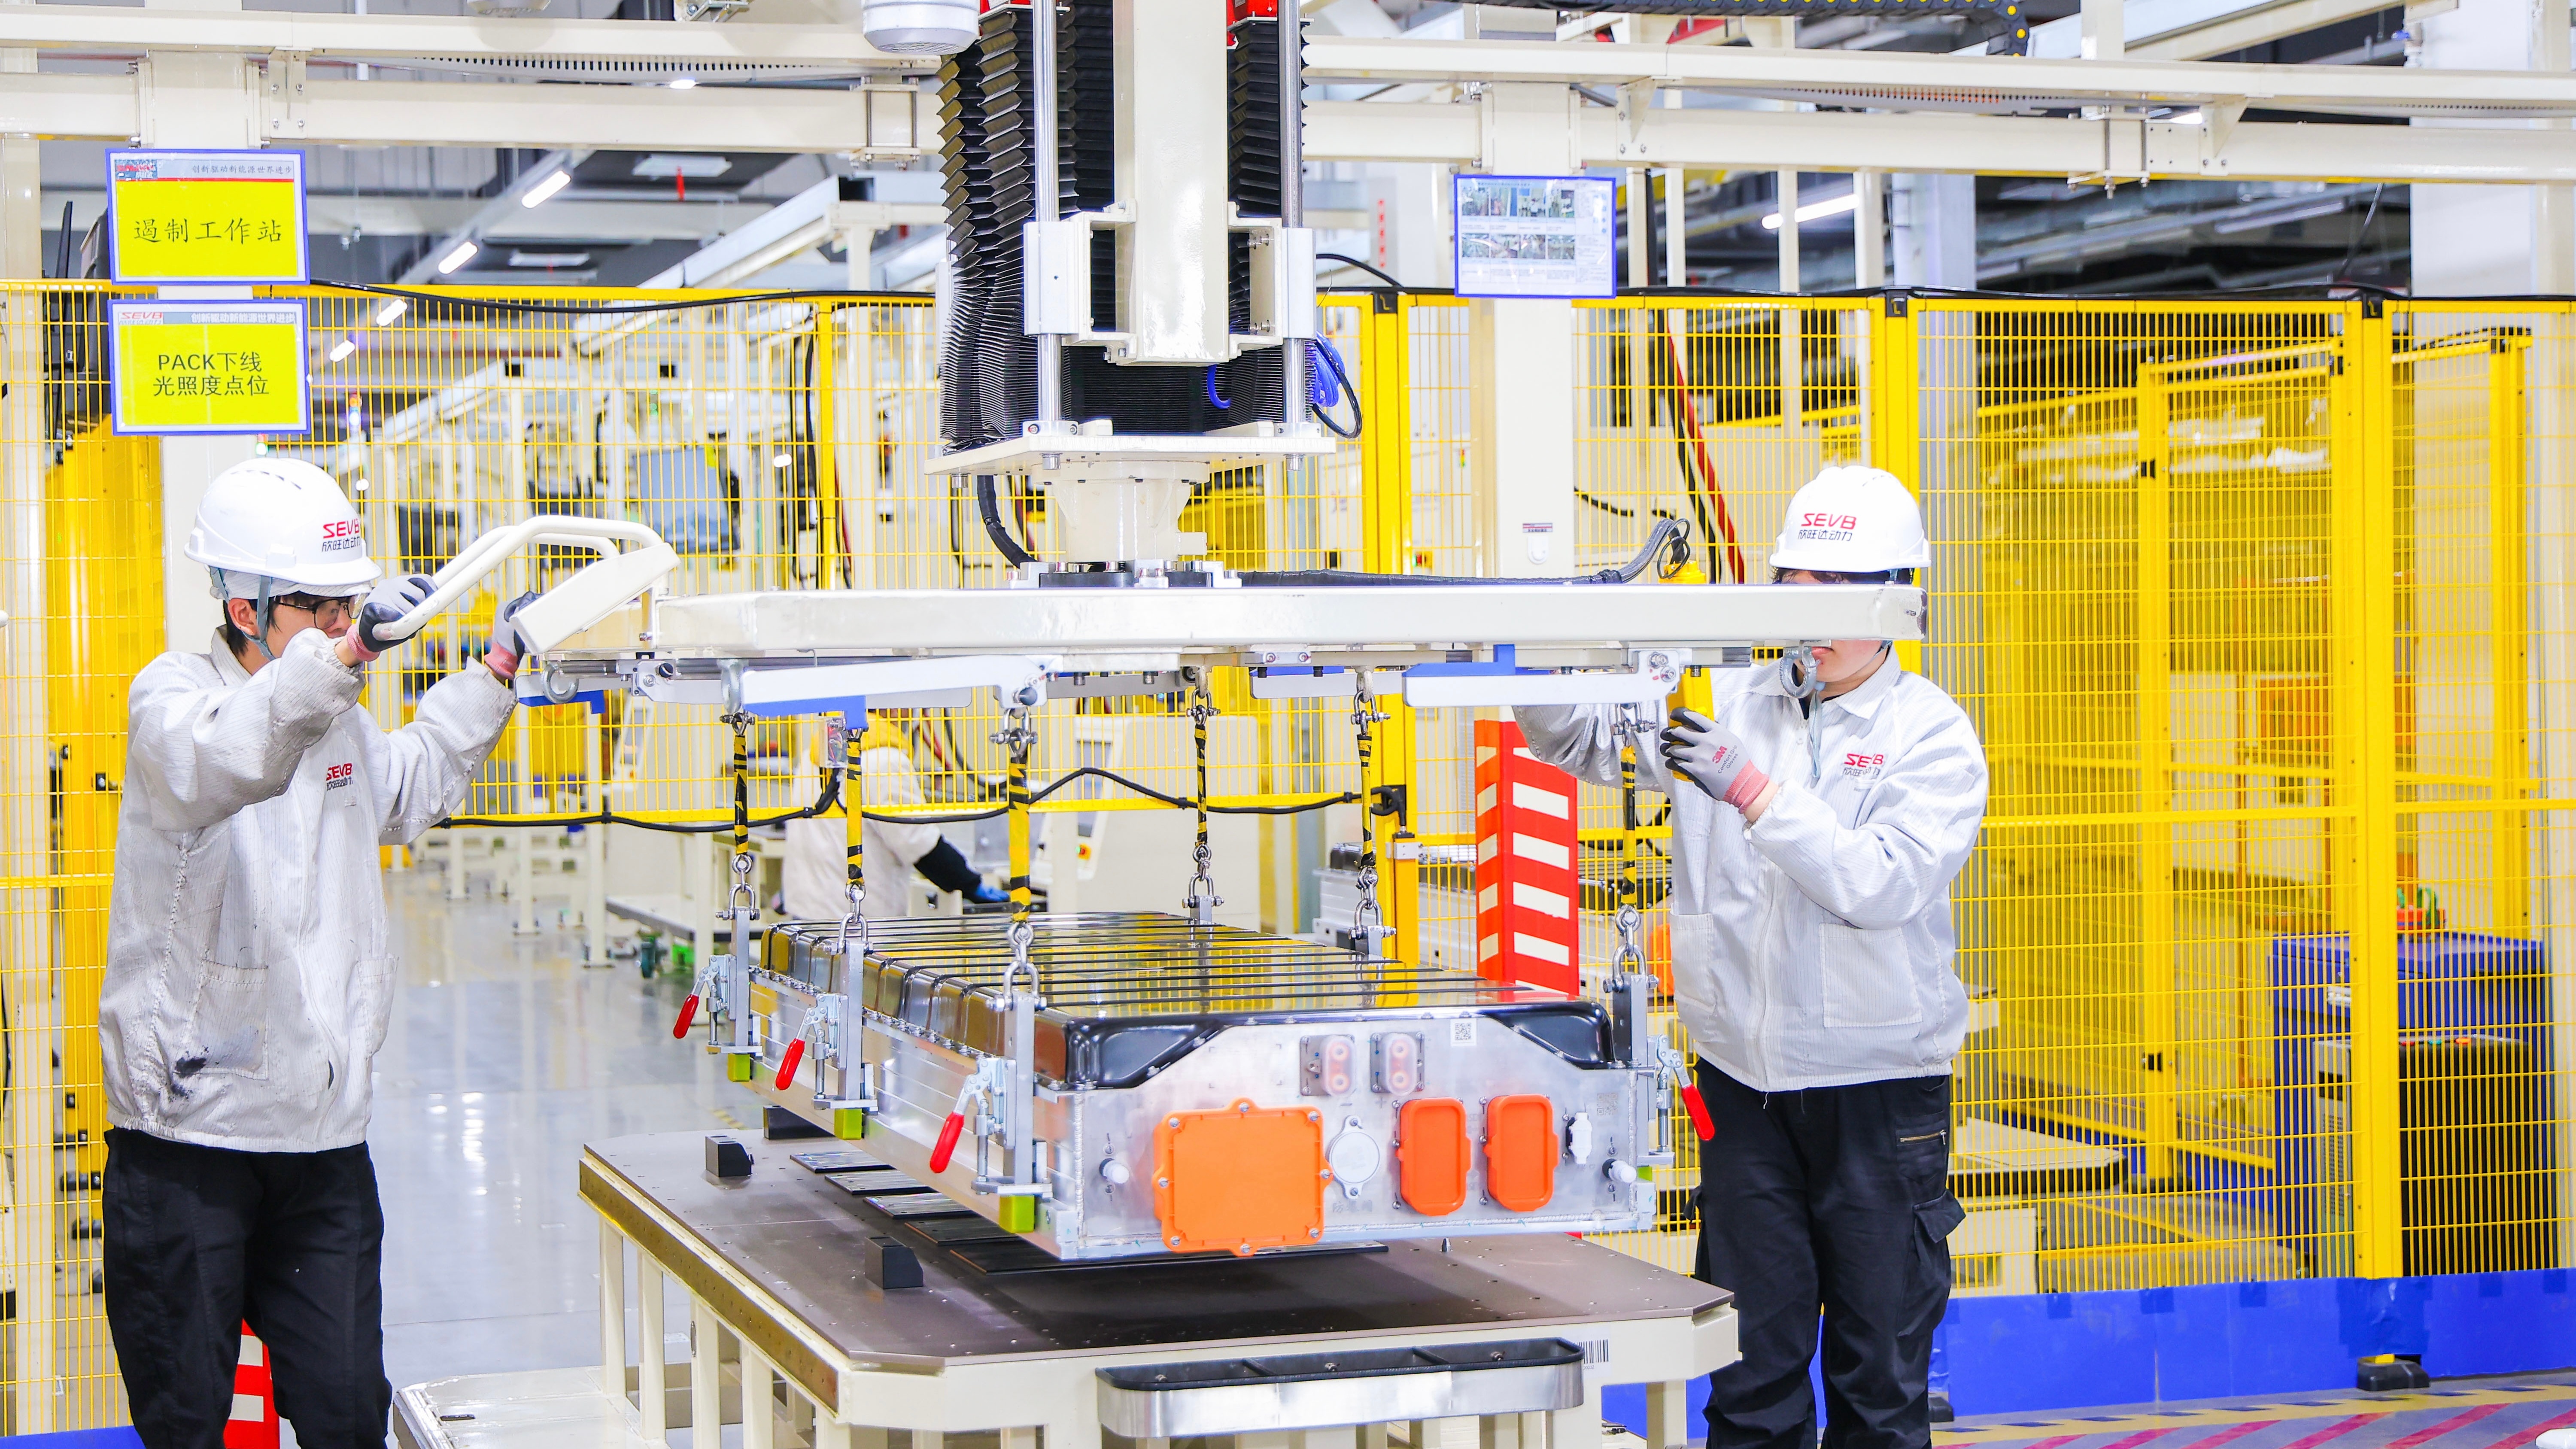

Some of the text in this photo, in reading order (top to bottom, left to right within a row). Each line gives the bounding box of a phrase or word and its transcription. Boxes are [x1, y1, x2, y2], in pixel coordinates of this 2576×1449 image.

[134, 218, 281, 244] 遏制工作站
[191, 313, 295, 323] 创新驱动新能源世界进步
[158, 351, 262, 372] PACK下线
[153, 375, 269, 396] 光照度点位
[323, 519, 359, 538] SEVB
[1801, 513, 1857, 530] SEVB
[1798, 529, 1853, 541] 欣旺达动力
[322, 536, 360, 552] 欣旺达动力
[1713, 746, 1727, 763] 3M
[1726, 754, 1738, 769] Gloves
[326, 763, 352, 781] SEVB
[1718, 755, 1732, 773] Comfort
